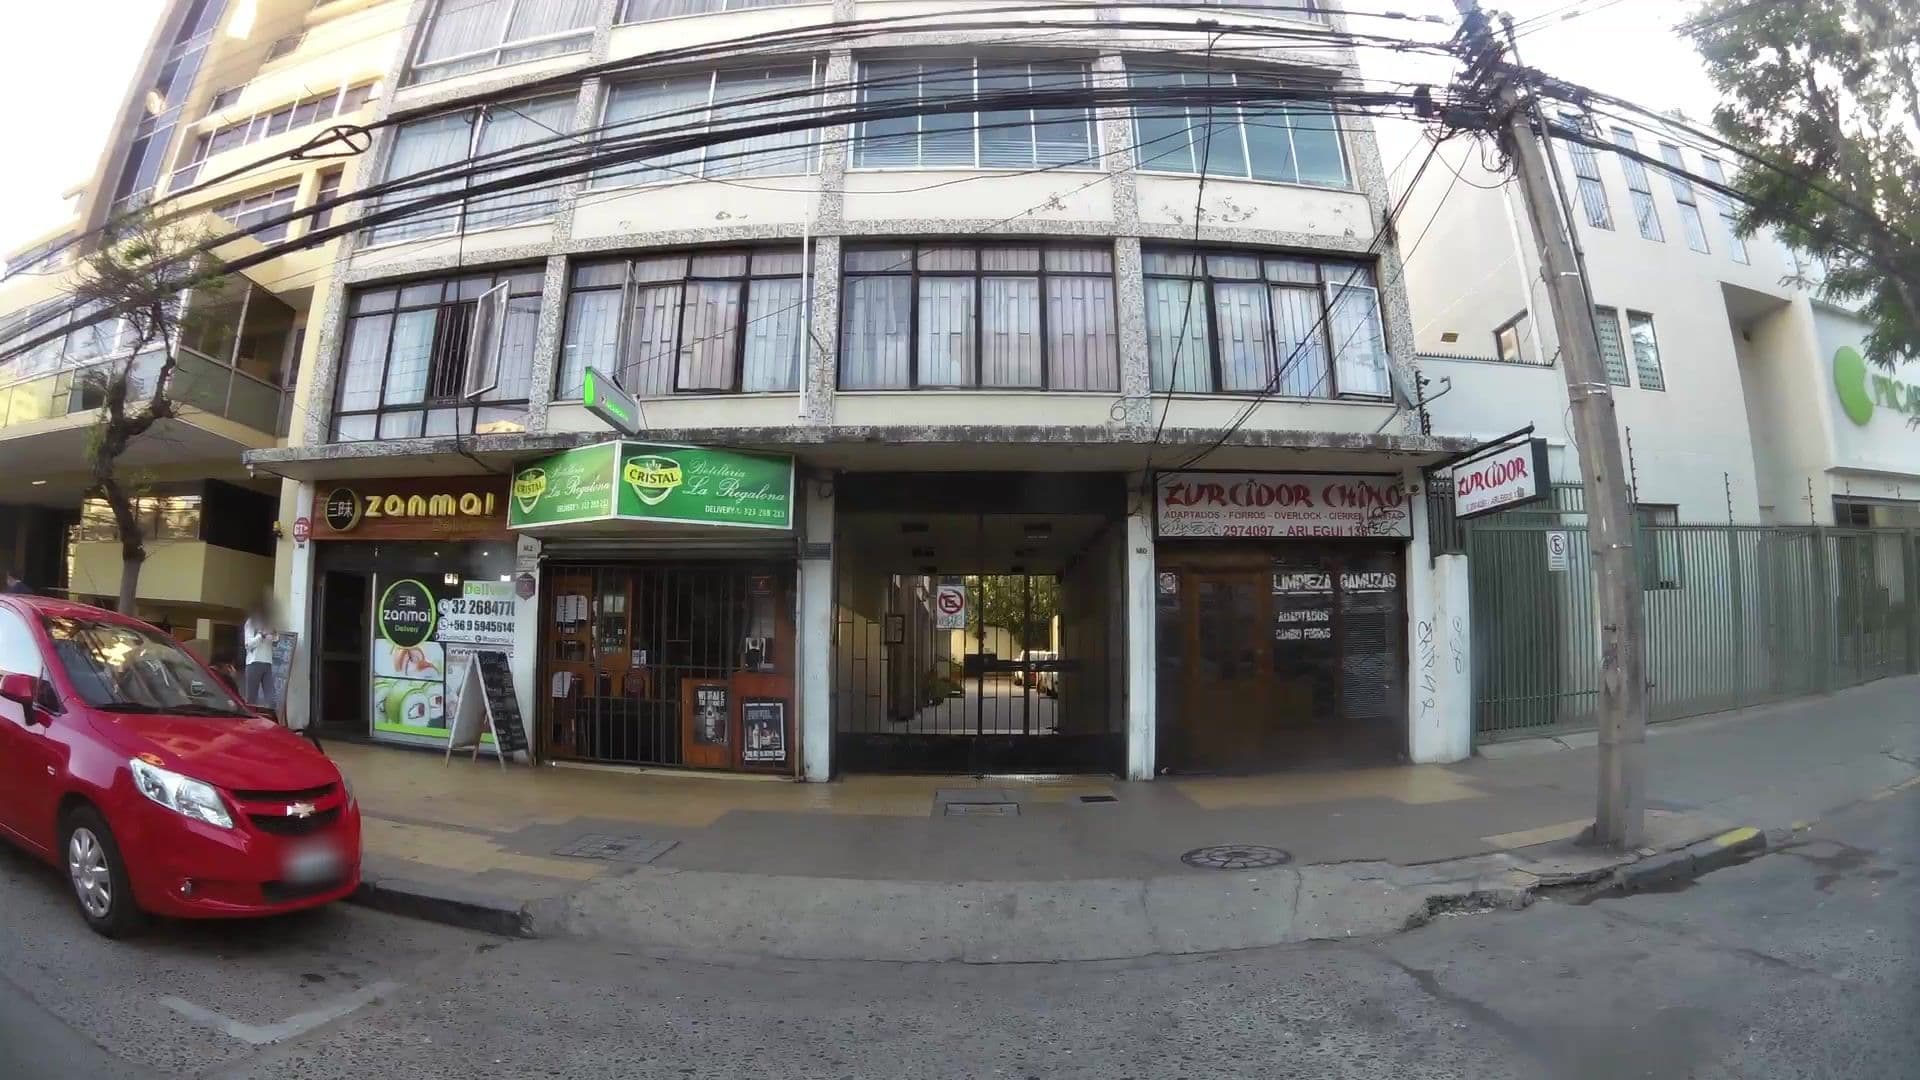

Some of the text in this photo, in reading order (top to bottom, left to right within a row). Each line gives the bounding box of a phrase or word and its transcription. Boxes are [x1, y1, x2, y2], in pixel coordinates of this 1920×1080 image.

[629, 469, 678, 484] CRISTAL
[682, 476, 785, 504] La Regalona
[1229, 511, 1266, 519] FORROS
[1274, 512, 1321, 520] OVERLOCK
[1222, 525, 1275, 537] 2974097
[1286, 525, 1343, 537] ARLEGUI
[1273, 573, 1397, 590] LIMPIEZA GAMUZAS
[451, 600, 466, 614] 32
[383, 608, 431, 622] zanmai
